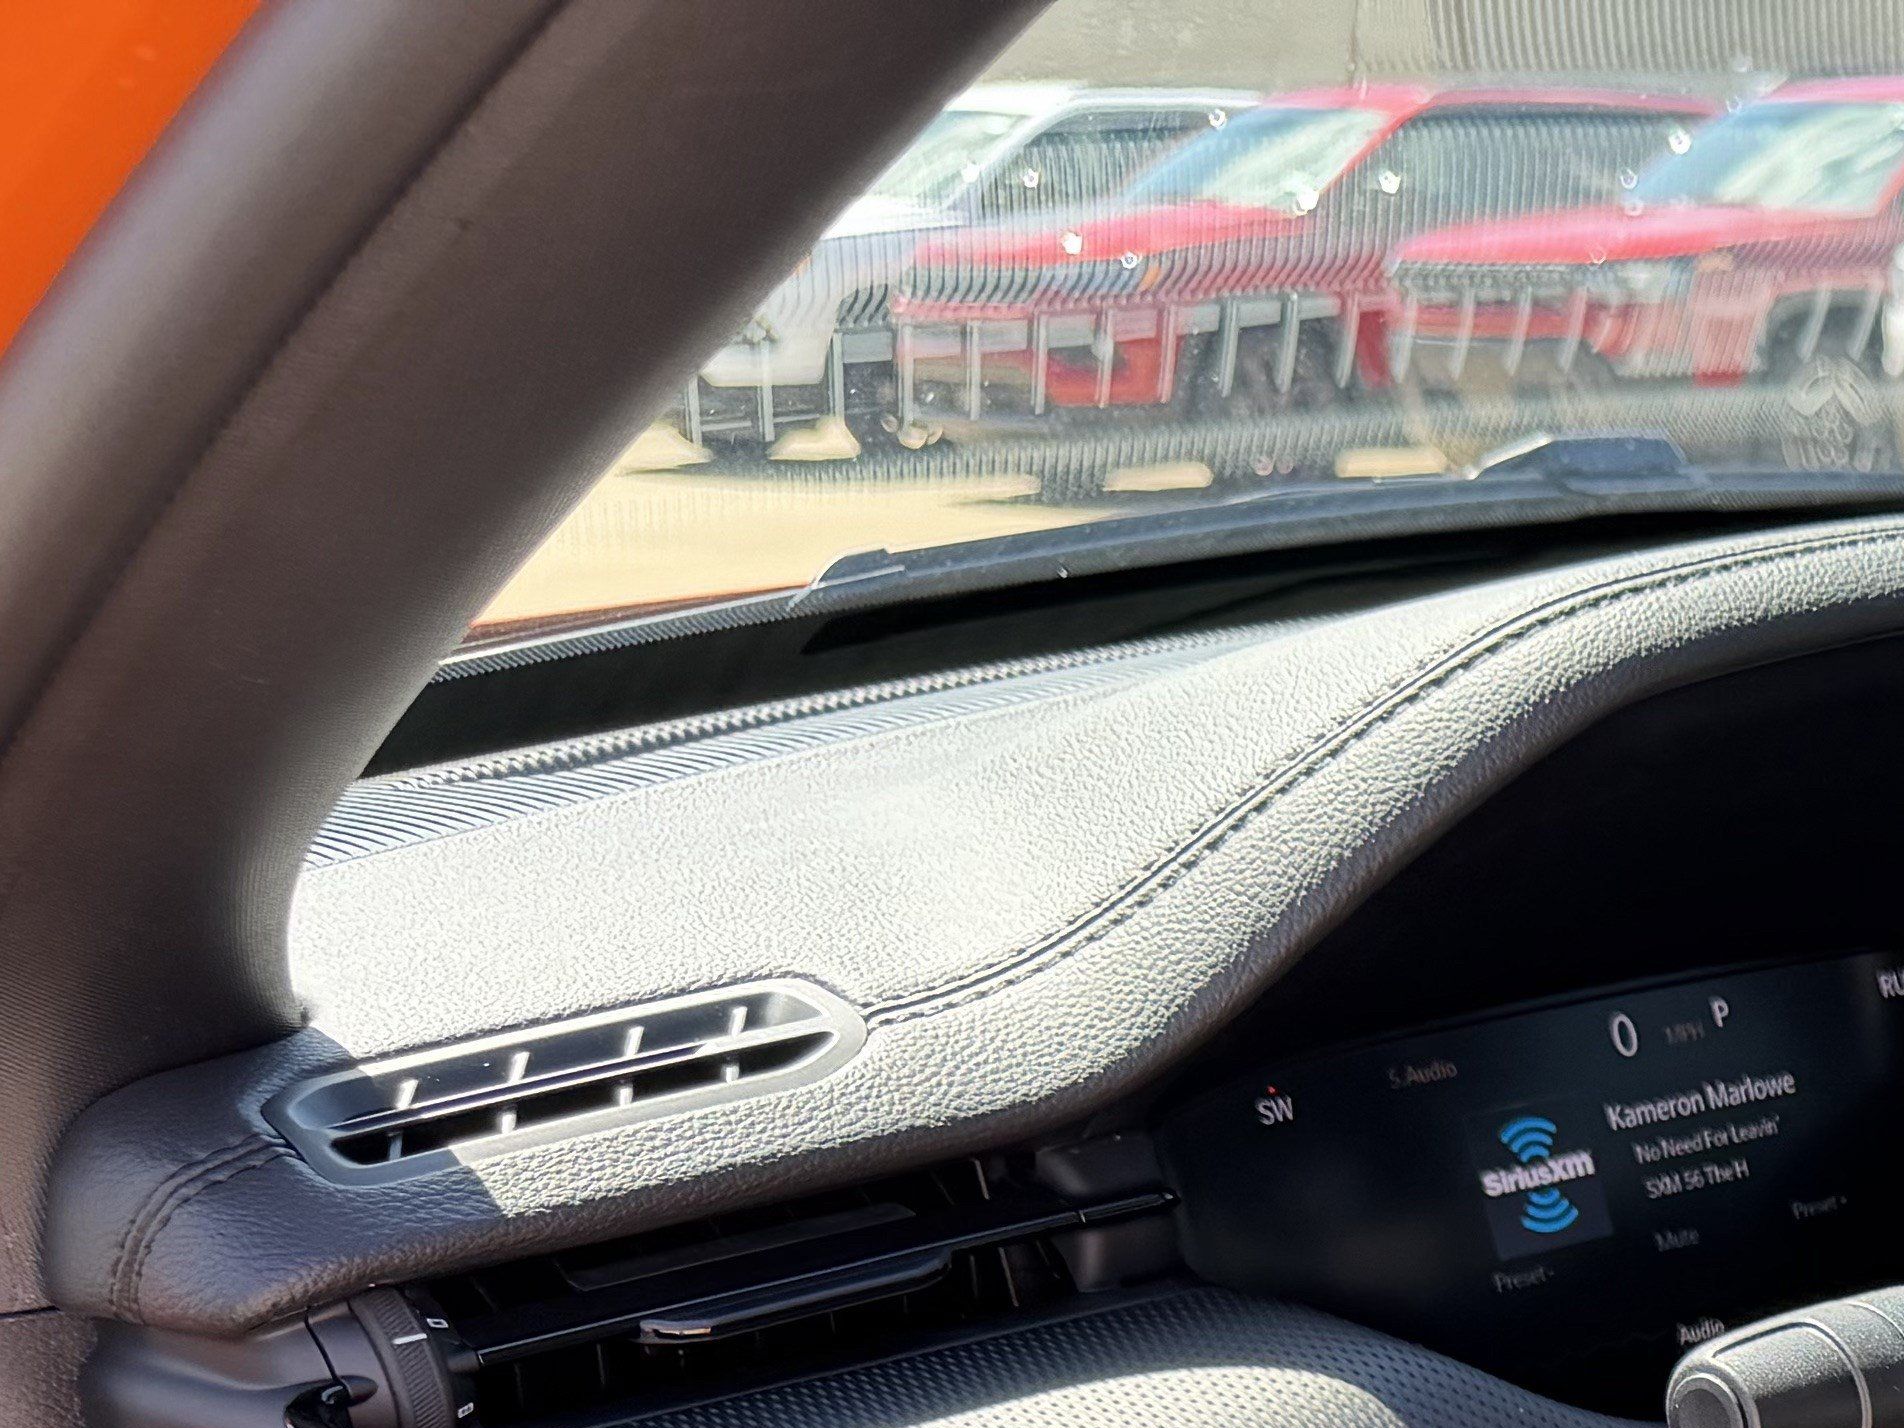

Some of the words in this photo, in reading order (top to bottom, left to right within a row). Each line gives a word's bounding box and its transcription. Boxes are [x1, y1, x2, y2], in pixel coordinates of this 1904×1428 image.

[1709, 996, 1730, 1028] P
[1255, 1096, 1294, 1127] SW
[1604, 1089, 1704, 1131] Kameron
[1702, 1070, 1796, 1111] Marlowe
[1675, 1316, 1726, 1346] Audio
